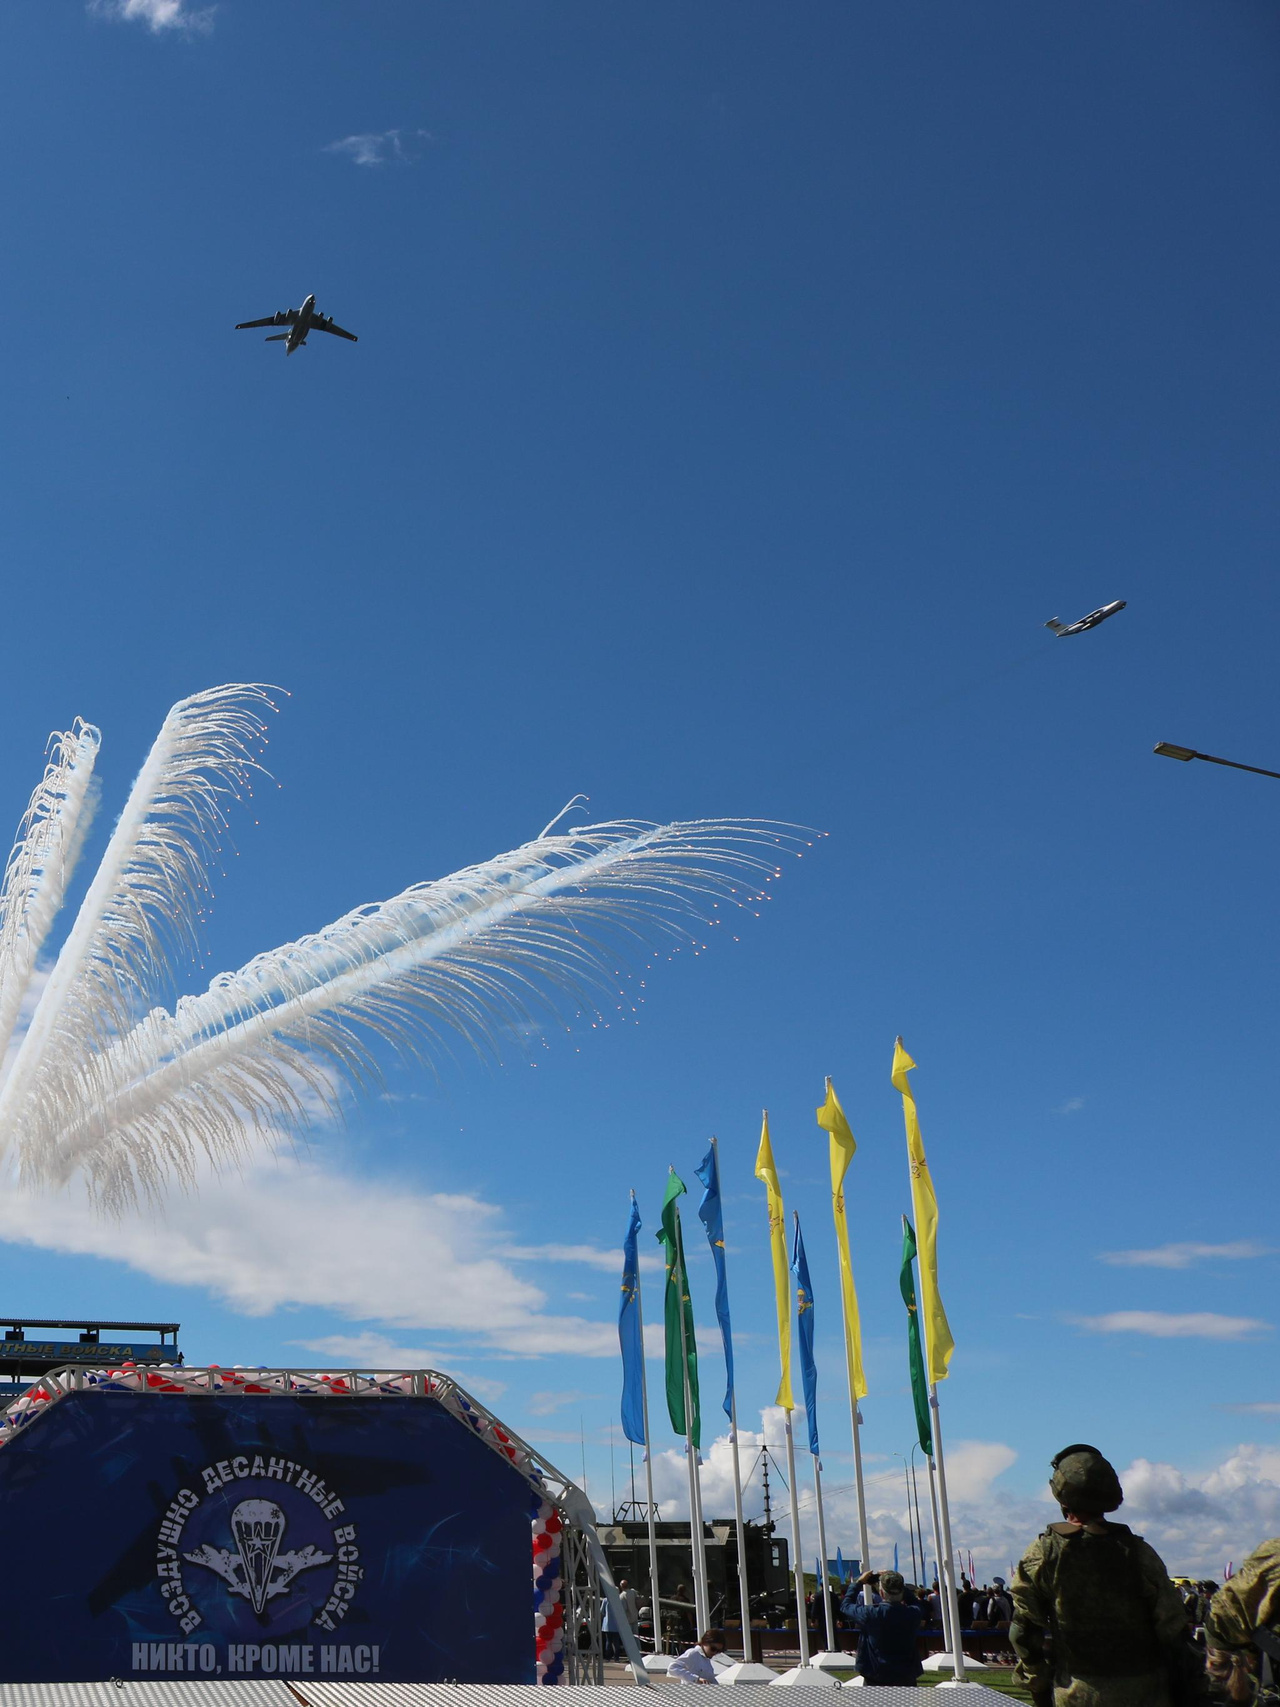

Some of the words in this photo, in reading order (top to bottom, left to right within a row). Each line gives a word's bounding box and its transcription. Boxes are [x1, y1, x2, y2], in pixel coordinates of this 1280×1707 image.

[59, 1344, 134, 1356] ВОЙСКА
[157, 1488, 203, 1635] ВОЗДУШНО
[201, 1454, 346, 1521] ДЕСАНТНЫЕ
[313, 1523, 364, 1632] ВОЙСКА
[131, 1642, 223, 1675] НИКТО,
[228, 1643, 315, 1673] КРОМЕ
[320, 1645, 380, 1673] НАС!
